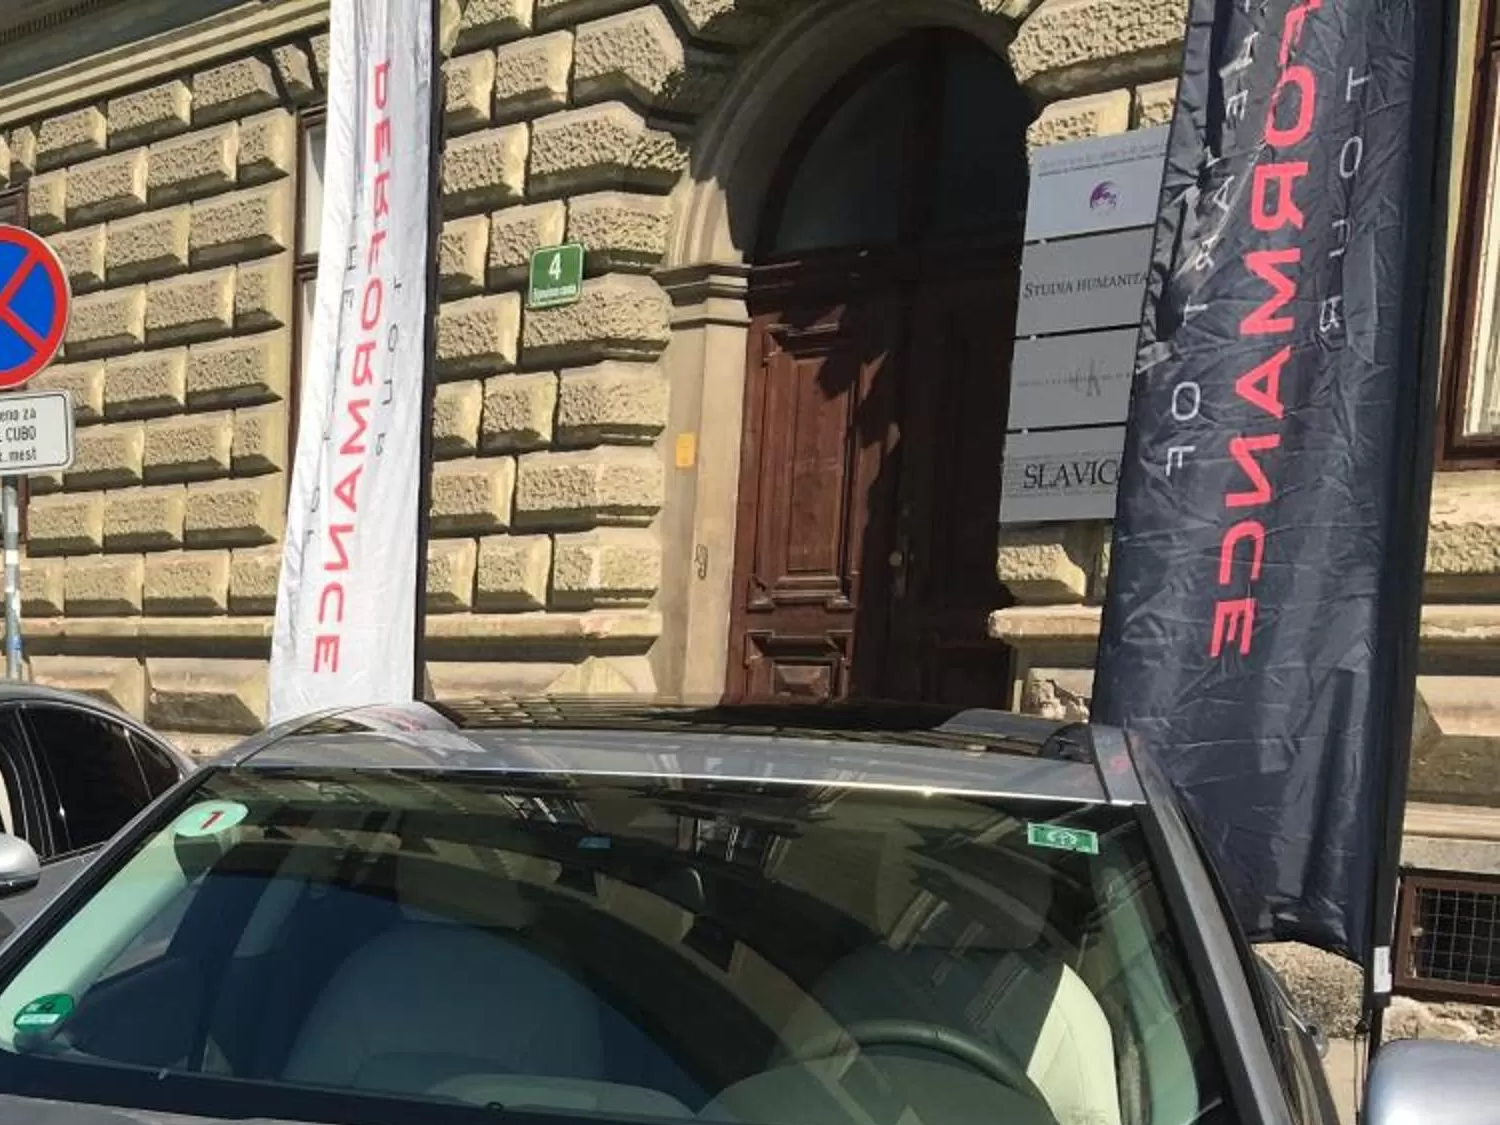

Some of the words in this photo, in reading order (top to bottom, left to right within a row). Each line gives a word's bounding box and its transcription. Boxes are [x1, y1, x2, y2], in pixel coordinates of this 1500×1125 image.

[548, 252, 562, 281] 4
[1076, 271, 1149, 292] HUMANITA
[5, 425, 37, 442] CUBO
[1023, 459, 1119, 488] SLAVIC
